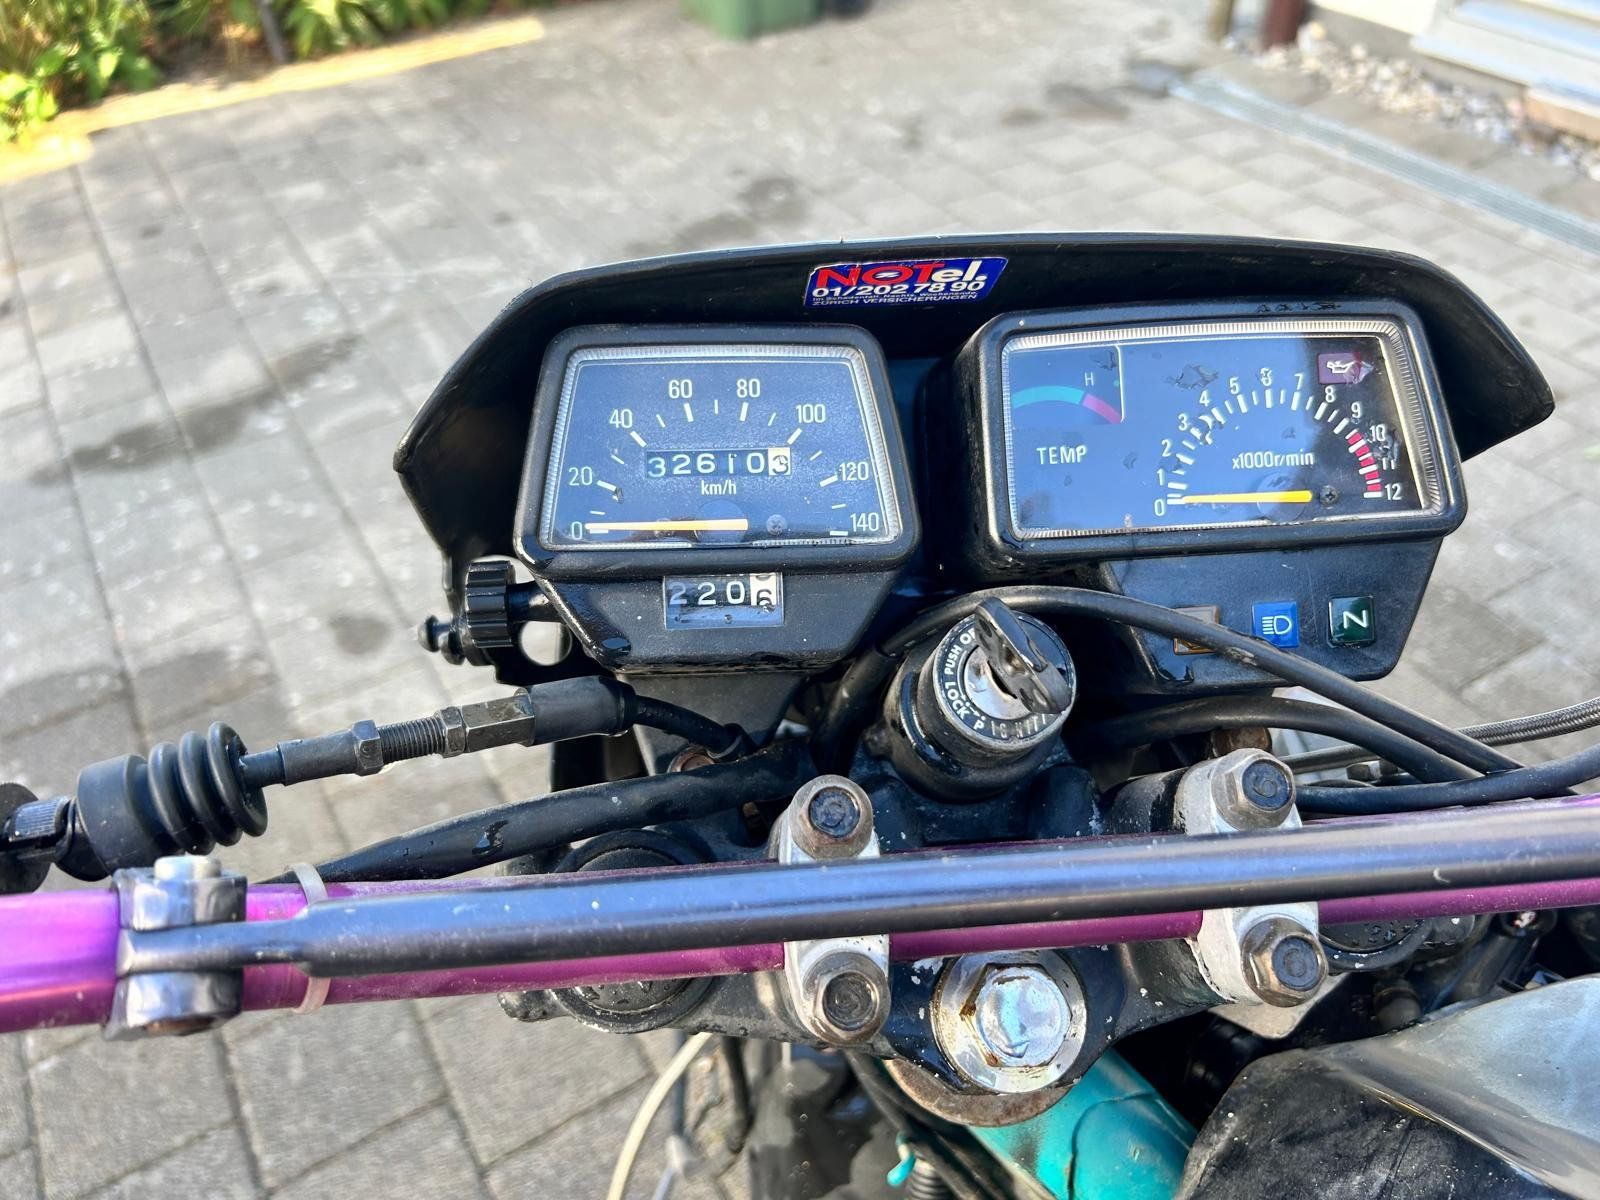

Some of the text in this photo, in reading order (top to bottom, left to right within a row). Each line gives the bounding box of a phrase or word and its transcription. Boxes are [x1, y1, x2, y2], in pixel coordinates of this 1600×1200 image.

[812, 281, 986, 298] 01/202 78 90
[862, 294, 978, 304] VERSICHERUNGEN
[668, 379, 693, 399] 60
[736, 378, 761, 398] 80
[1085, 372, 1095, 387] H
[1229, 376, 1240, 395] 5
[1294, 372, 1304, 391] 7
[1199, 390, 1210, 407] 4
[1324, 385, 1336, 403] 8
[609, 408, 633, 429] 40
[795, 403, 826, 424] 100
[1350, 401, 1362, 419] 9
[1178, 413, 1189, 431] 3
[1368, 423, 1387, 443] 10
[1037, 446, 1087, 465] TEMP
[1161, 438, 1172, 457] 2
[1232, 449, 1315, 470] x1000r/min
[568, 466, 593, 486] 20
[839, 461, 869, 481] 120
[1156, 467, 1164, 486] 1
[700, 479, 738, 496] km/h
[1384, 483, 1403, 501] 12
[1154, 498, 1166, 517] 0
[851, 512, 879, 531] 140
[571, 522, 583, 541] 0
[1342, 609, 1370, 630] N
[944, 644, 963, 676] PUSH
[944, 681, 971, 720] LOCK
[973, 719, 986, 731] P
